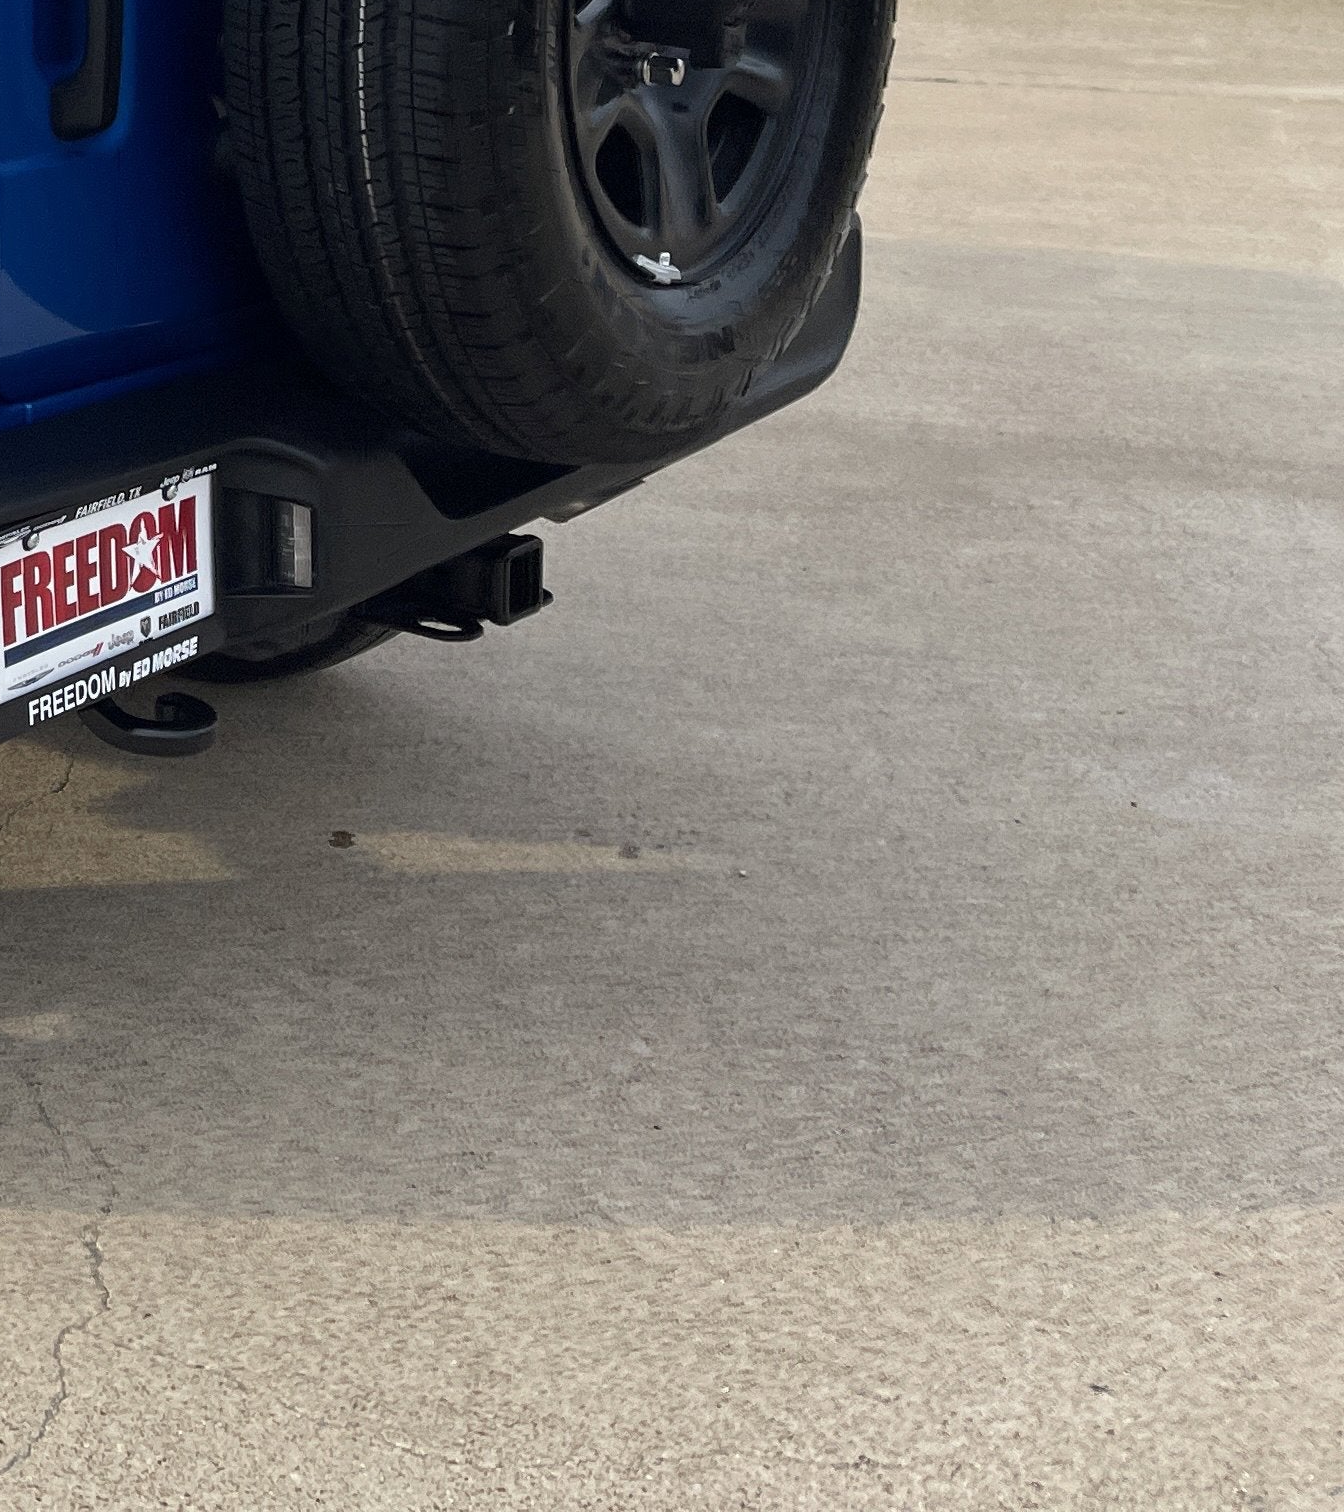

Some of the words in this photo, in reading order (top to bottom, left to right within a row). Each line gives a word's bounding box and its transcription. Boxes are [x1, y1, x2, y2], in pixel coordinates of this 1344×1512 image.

[128, 485, 143, 501] TX
[194, 463, 217, 476] RAM
[0, 495, 198, 648] FREEDOM
[28, 666, 116, 727] FREEDOM
[132, 656, 152, 681] ED
[152, 635, 199, 673] MORSE
